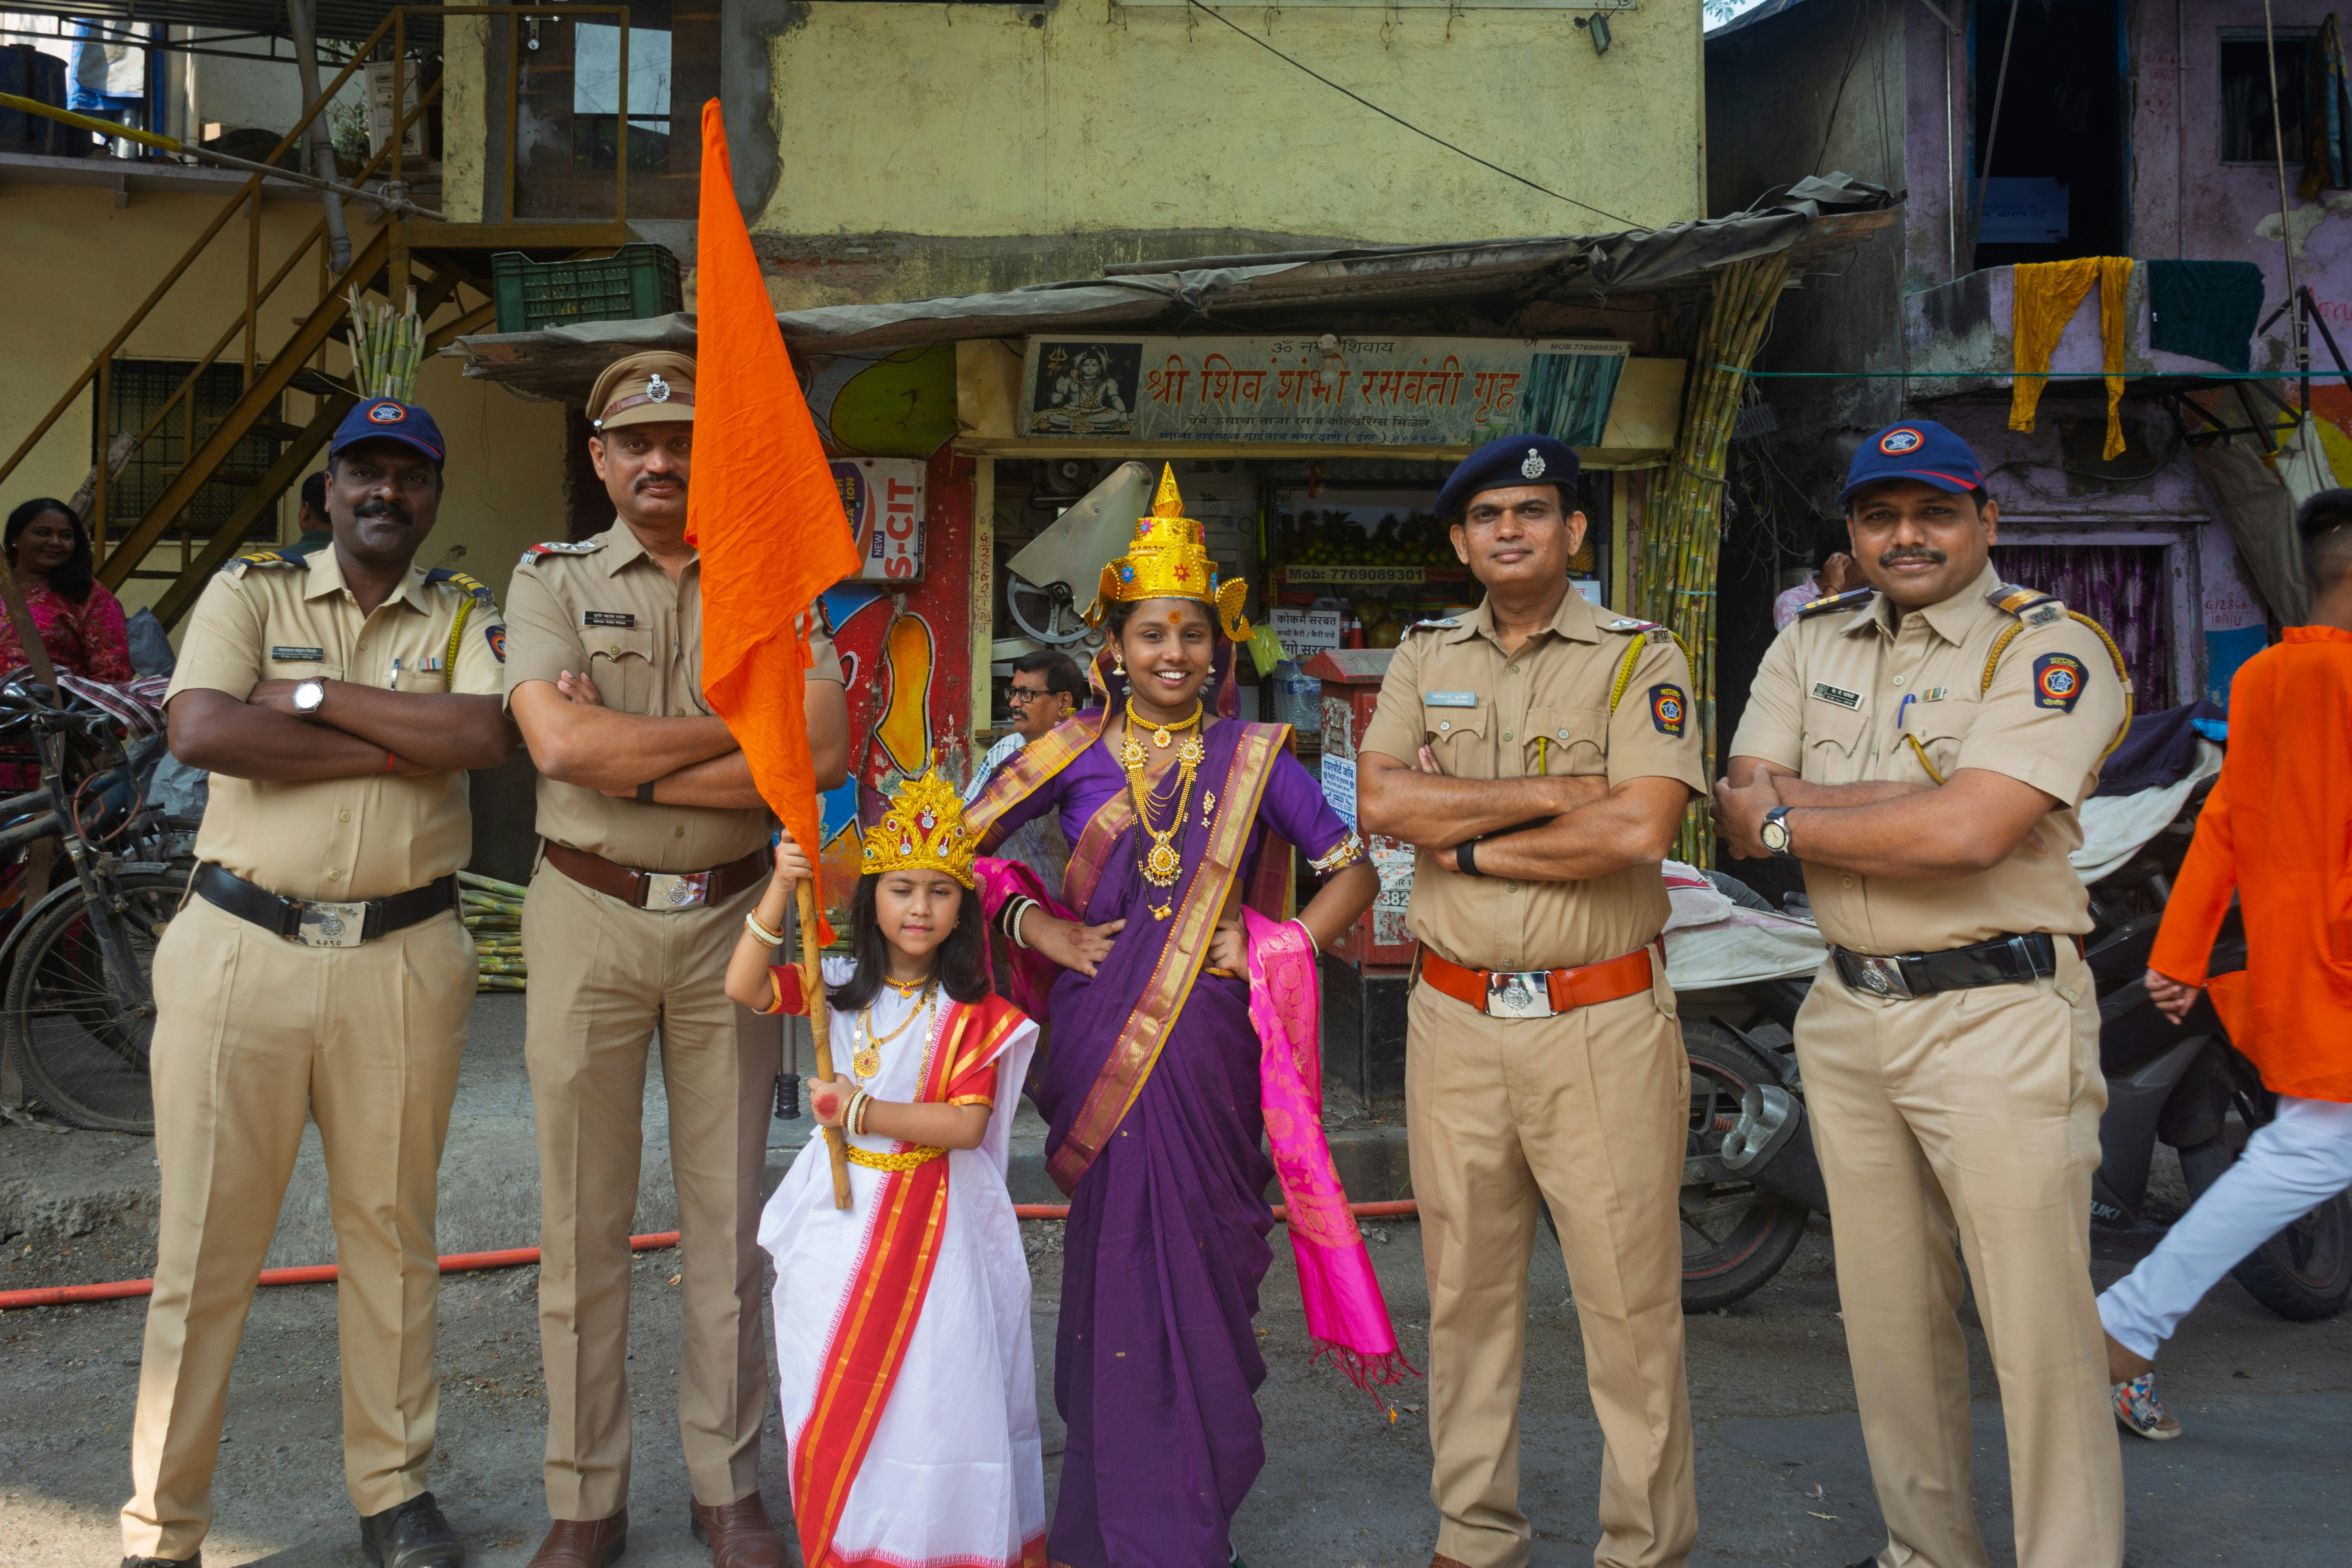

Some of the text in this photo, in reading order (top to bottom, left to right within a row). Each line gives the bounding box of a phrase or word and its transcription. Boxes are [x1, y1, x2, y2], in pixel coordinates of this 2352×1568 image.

[1271, 340, 1293, 353] ॐ
[1342, 339, 1395, 353] शिवाय
[1146, 354, 1191, 405] श्री
[1200, 354, 1268, 405] शिव
[1361, 355, 1465, 407] रसवंती
[1474, 372, 1521, 423] गृह
[1188, 414, 1209, 425] येथे
[1213, 417, 1255, 425] ऊसाचा
[1260, 417, 1290, 425] ताजा
[1294, 417, 1311, 425] रस
[1393, 416, 1431, 427] मिळेल
[885, 477, 915, 579] S-CIT
[874, 534, 882, 556] NEW
[1289, 568, 1423, 581] Mob: 7769089301
[1308, 616, 1337, 626] सरबत
[1293, 629, 1305, 637] कैरी
[1311, 630, 1323, 638] कैरी
[1325, 630, 1336, 639] पन्हे
